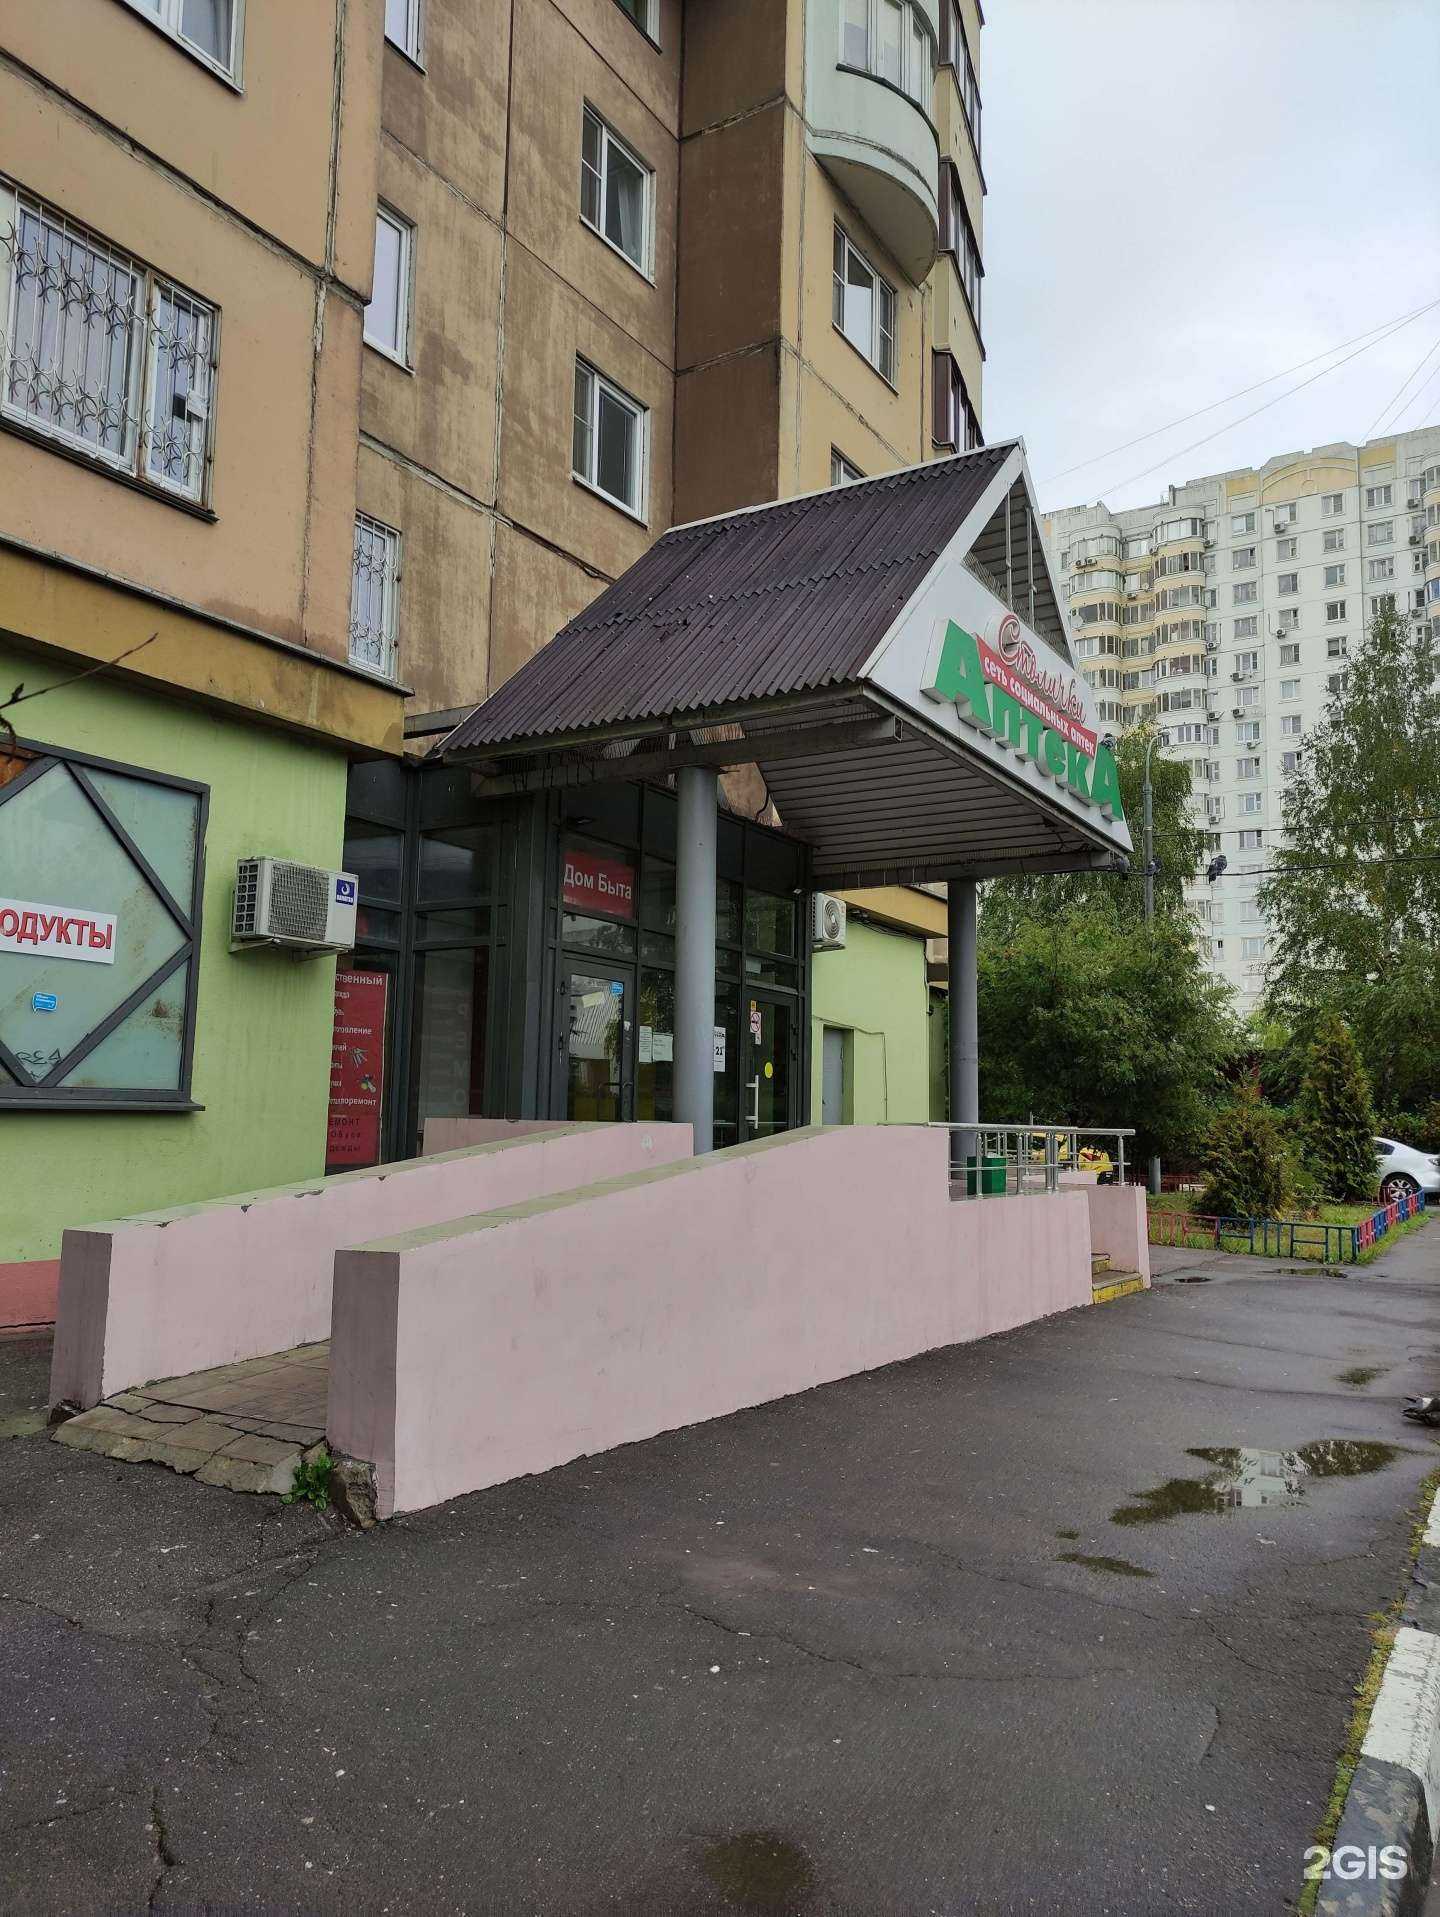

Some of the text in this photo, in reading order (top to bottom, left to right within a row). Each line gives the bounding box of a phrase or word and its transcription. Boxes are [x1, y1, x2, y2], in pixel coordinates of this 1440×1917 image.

[984, 657, 1095, 756] сеть социальных аптек
[563, 863, 632, 900] Дом Быта
[0, 909, 113, 950] ОДУКТЫ
